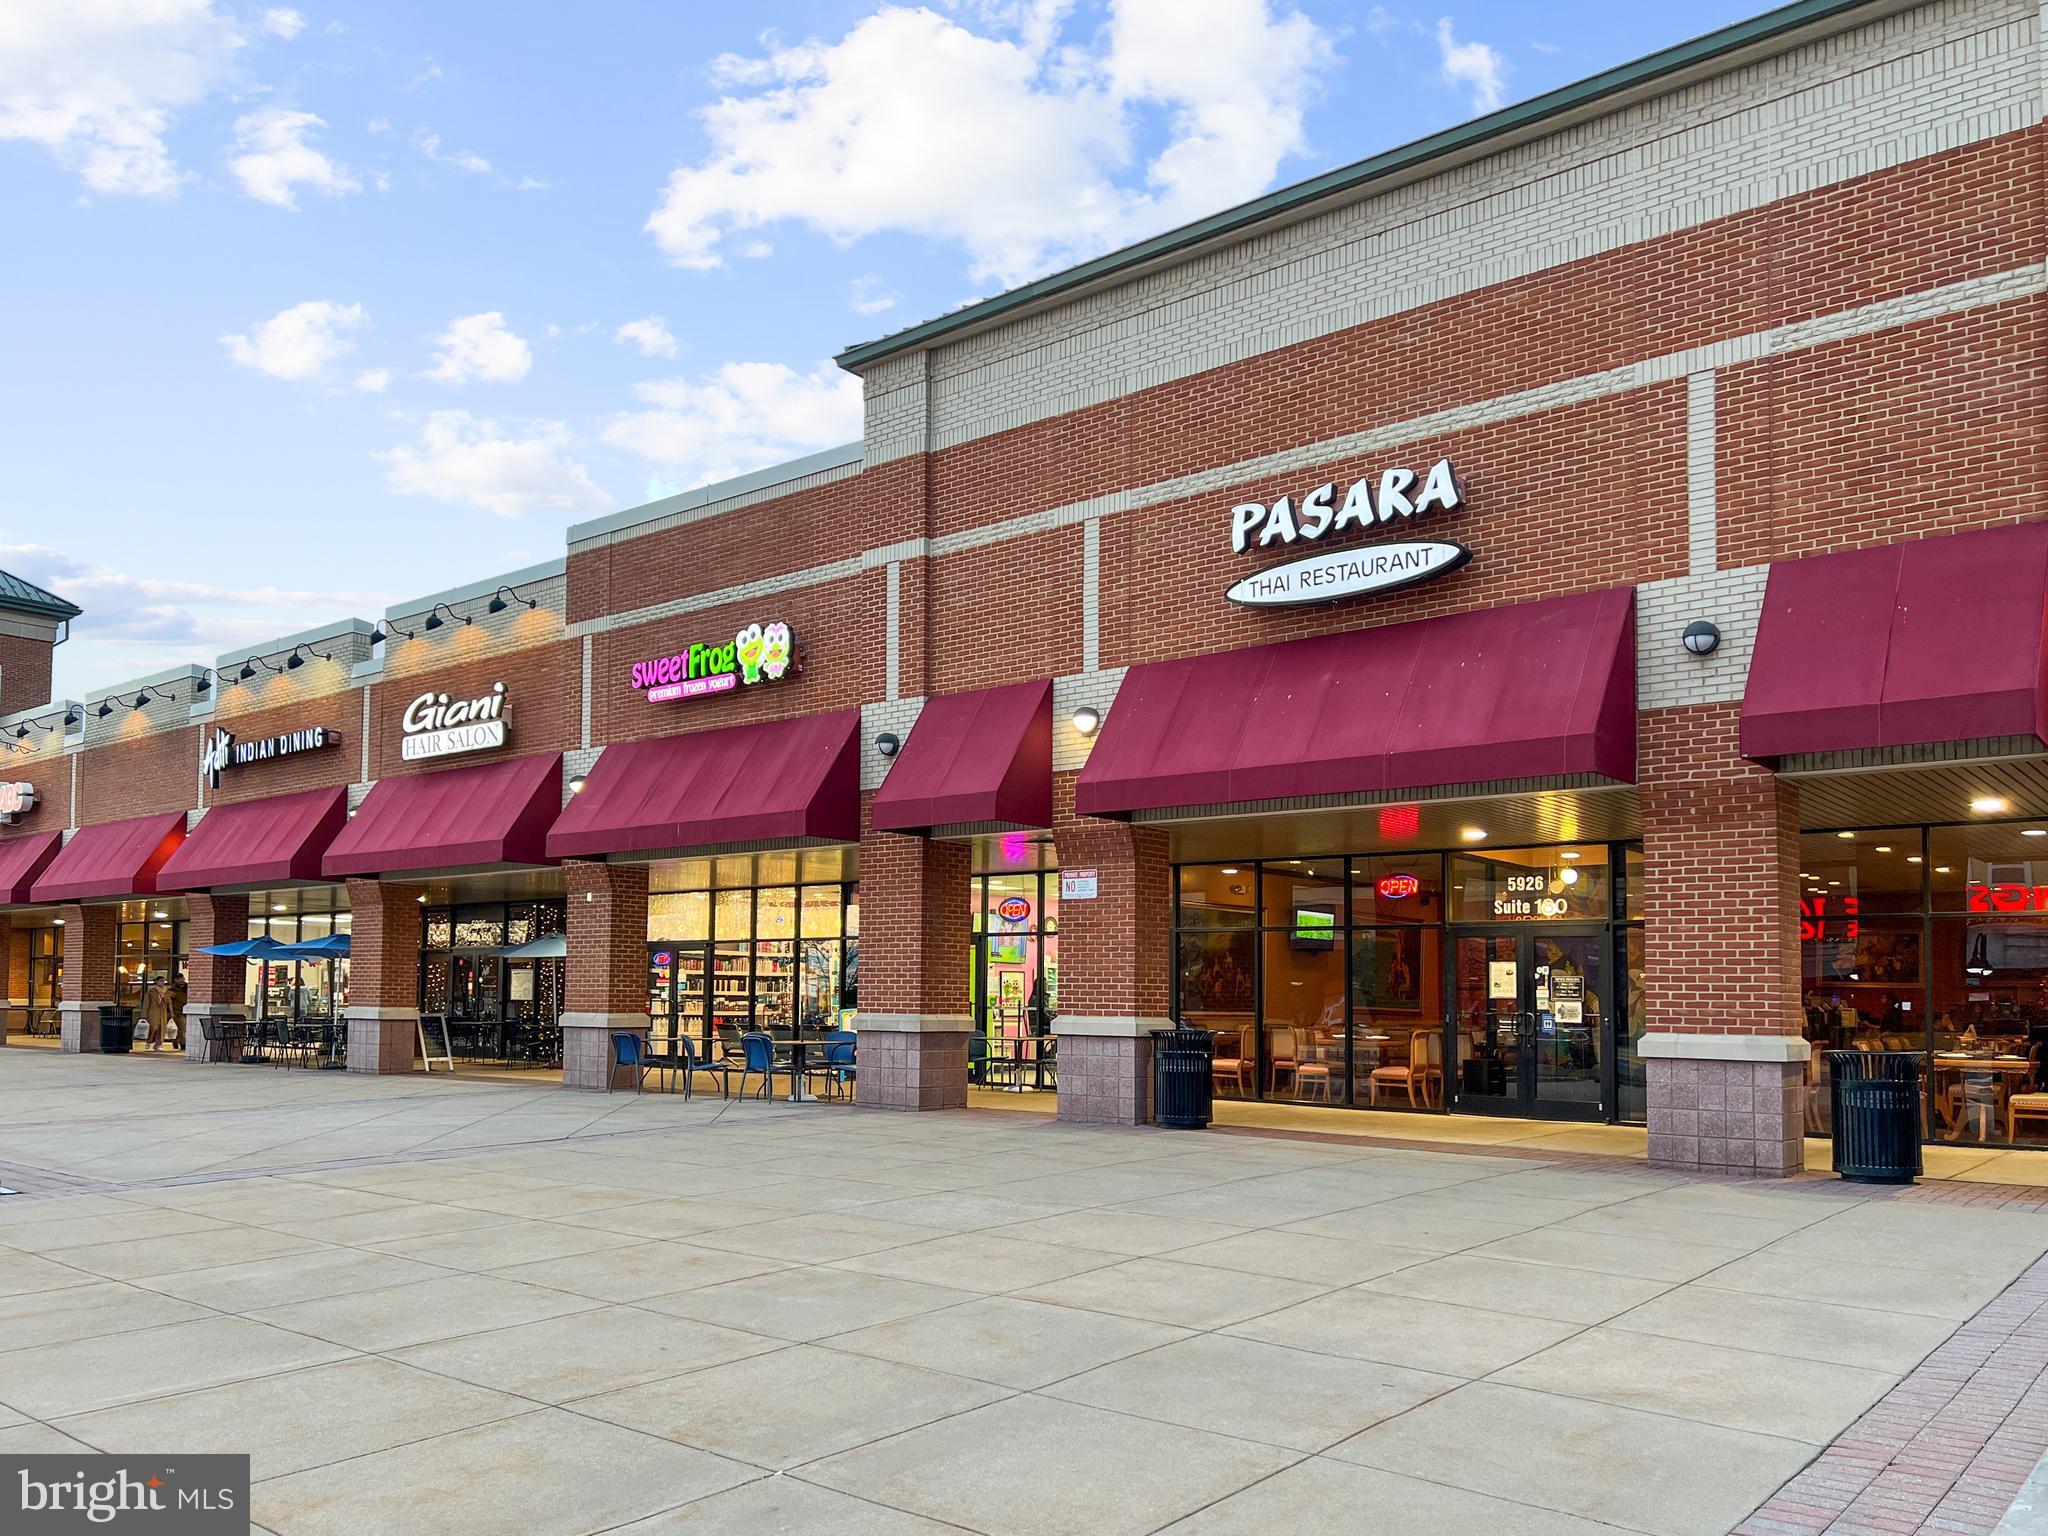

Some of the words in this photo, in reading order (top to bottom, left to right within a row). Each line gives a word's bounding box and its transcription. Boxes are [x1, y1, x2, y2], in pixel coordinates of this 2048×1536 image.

[1231, 458, 1459, 554] PASARA
[1249, 575, 1290, 598] THAI
[1300, 547, 1433, 589] RESTAURANT
[631, 640, 736, 689] sweetFrog
[649, 684, 681, 700] premium
[683, 680, 706, 696] frozen
[402, 682, 504, 733] Giani
[236, 737, 275, 764] INDIAN
[280, 726, 323, 755] DINING
[405, 734, 442, 757] HAIR
[447, 723, 500, 751] SALON
[1065, 880, 1076, 892] NO
[1380, 879, 1418, 895] OPEN
[1507, 875, 1544, 892] 5926
[1001, 903, 1027, 917] OPEN
[1494, 898, 1531, 915] Suite
